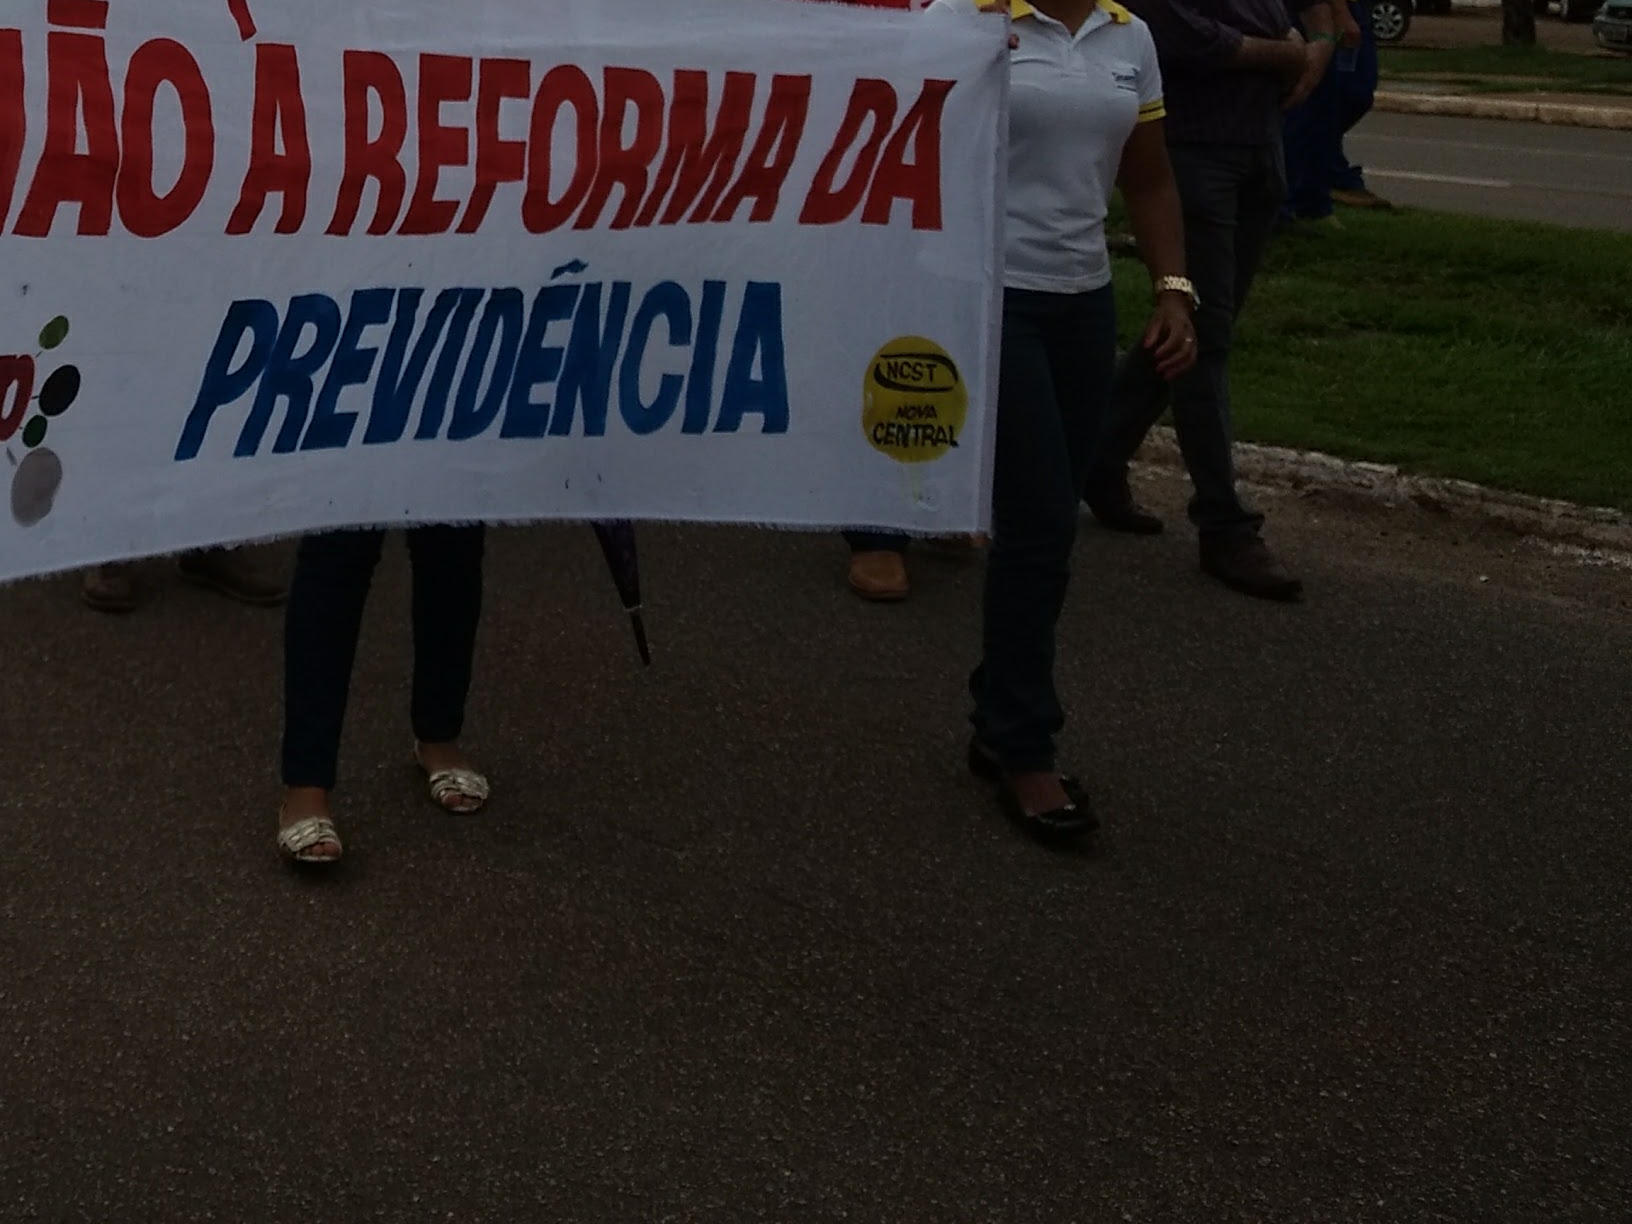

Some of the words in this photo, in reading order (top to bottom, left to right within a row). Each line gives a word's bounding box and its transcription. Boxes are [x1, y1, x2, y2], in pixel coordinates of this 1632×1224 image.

[324, 49, 812, 237] REFORMA
[798, 77, 958, 232] DA
[887, 361, 938, 382] NCST
[895, 404, 938, 421] NOVA
[873, 422, 959, 449] CENTRAL
